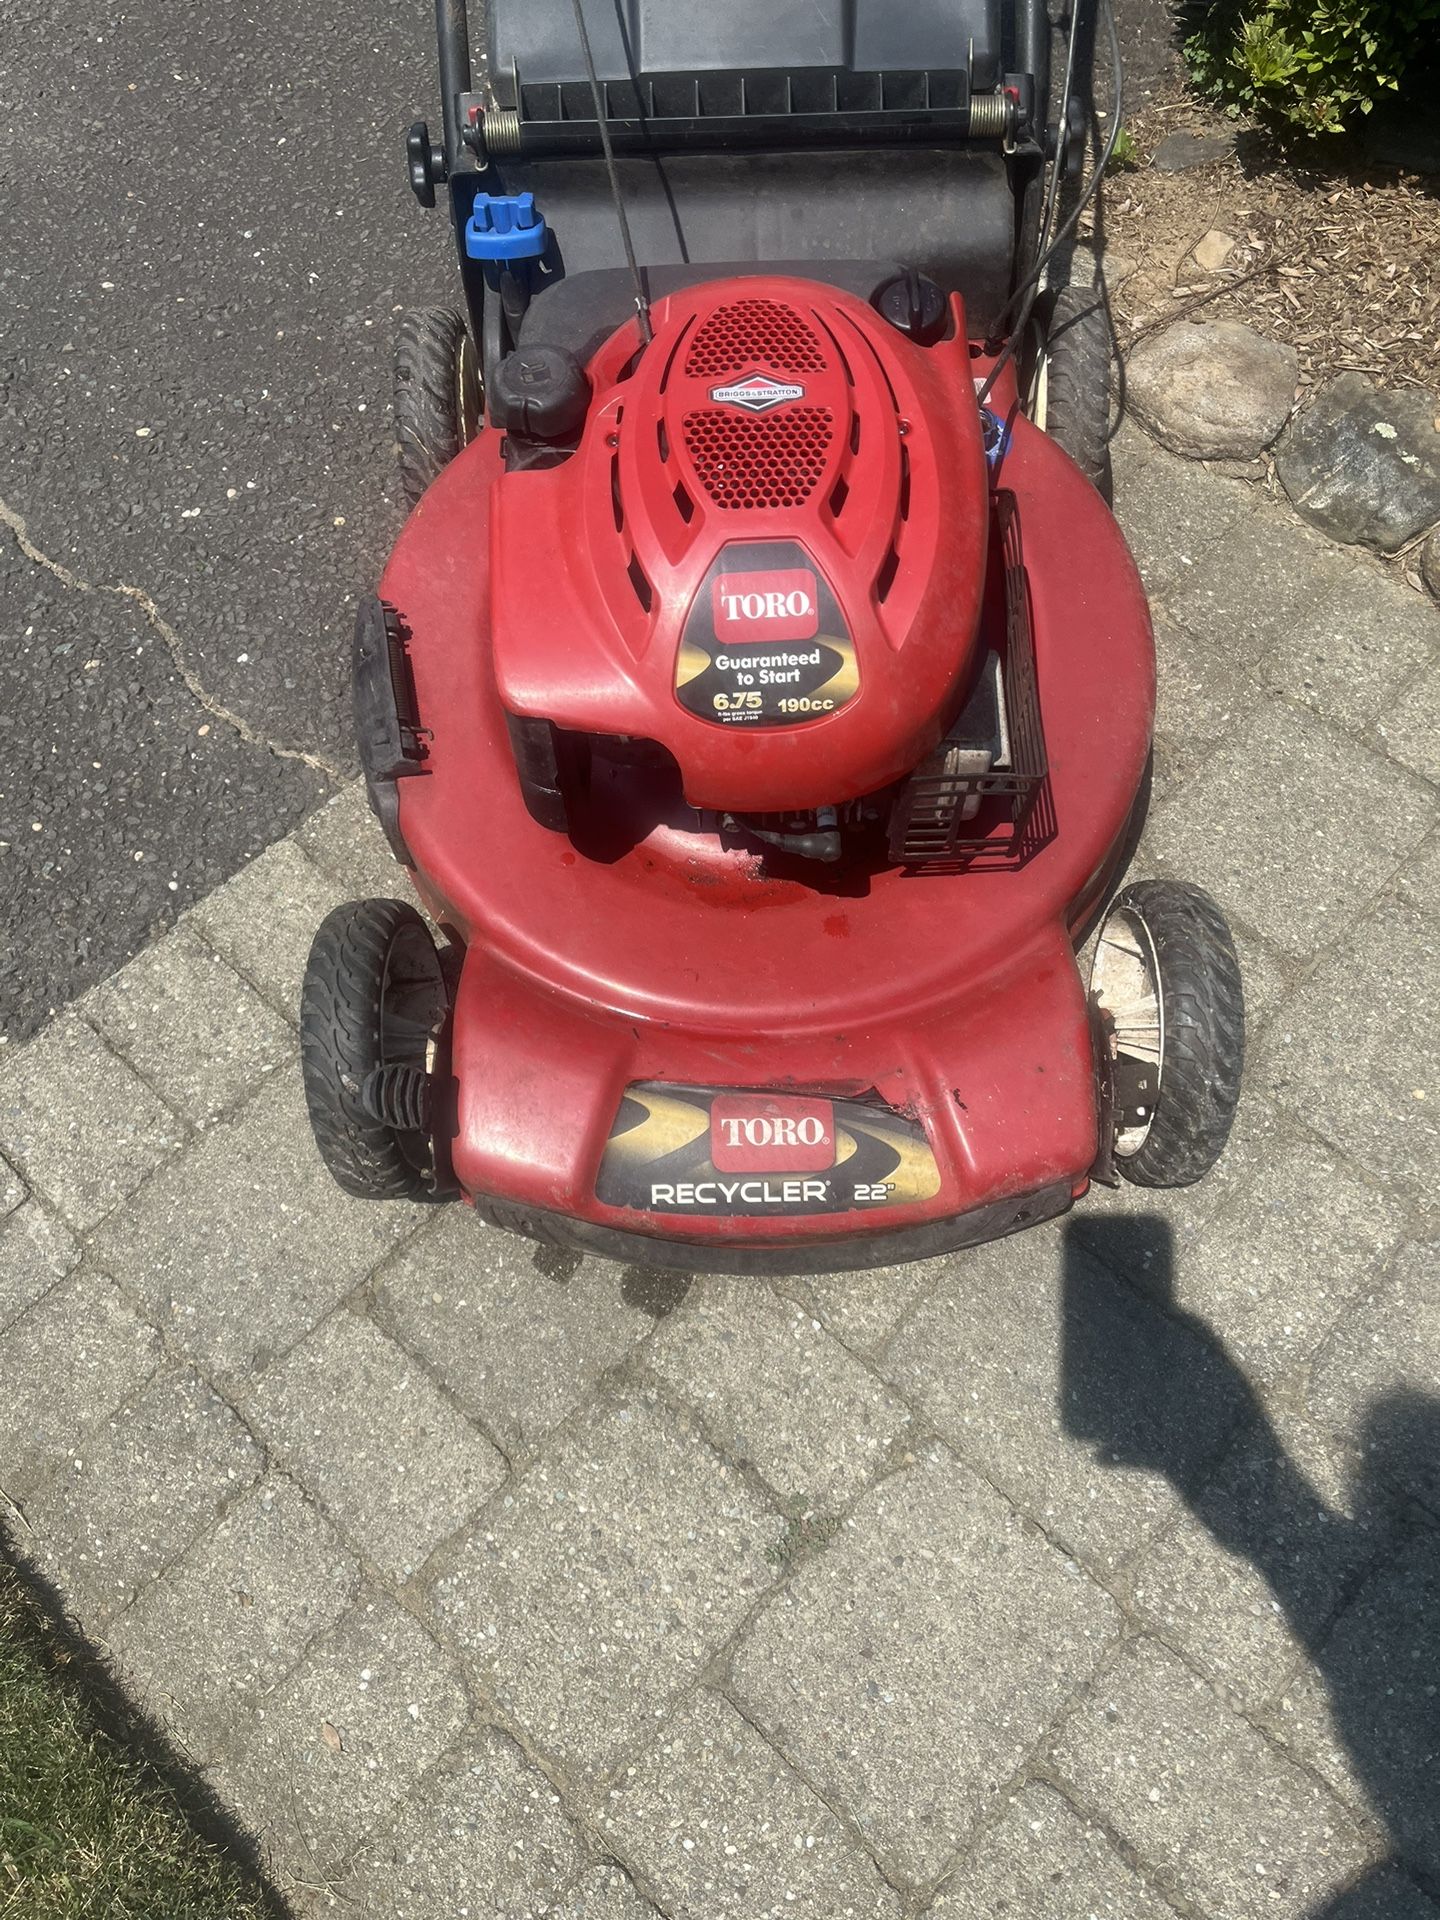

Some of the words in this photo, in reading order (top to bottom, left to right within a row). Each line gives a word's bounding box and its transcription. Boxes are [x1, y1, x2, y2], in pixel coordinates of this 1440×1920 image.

[721, 590, 810, 621] TORO
[715, 649, 821, 670] Guaranteed
[736, 672, 755, 686] to
[759, 669, 801, 685] Start
[713, 691, 763, 710] 6.75
[777, 697, 834, 713] 190cc
[721, 1116, 825, 1147] TORO
[651, 1181, 828, 1205] RECYCLER
[853, 1183, 896, 1201] 22"
